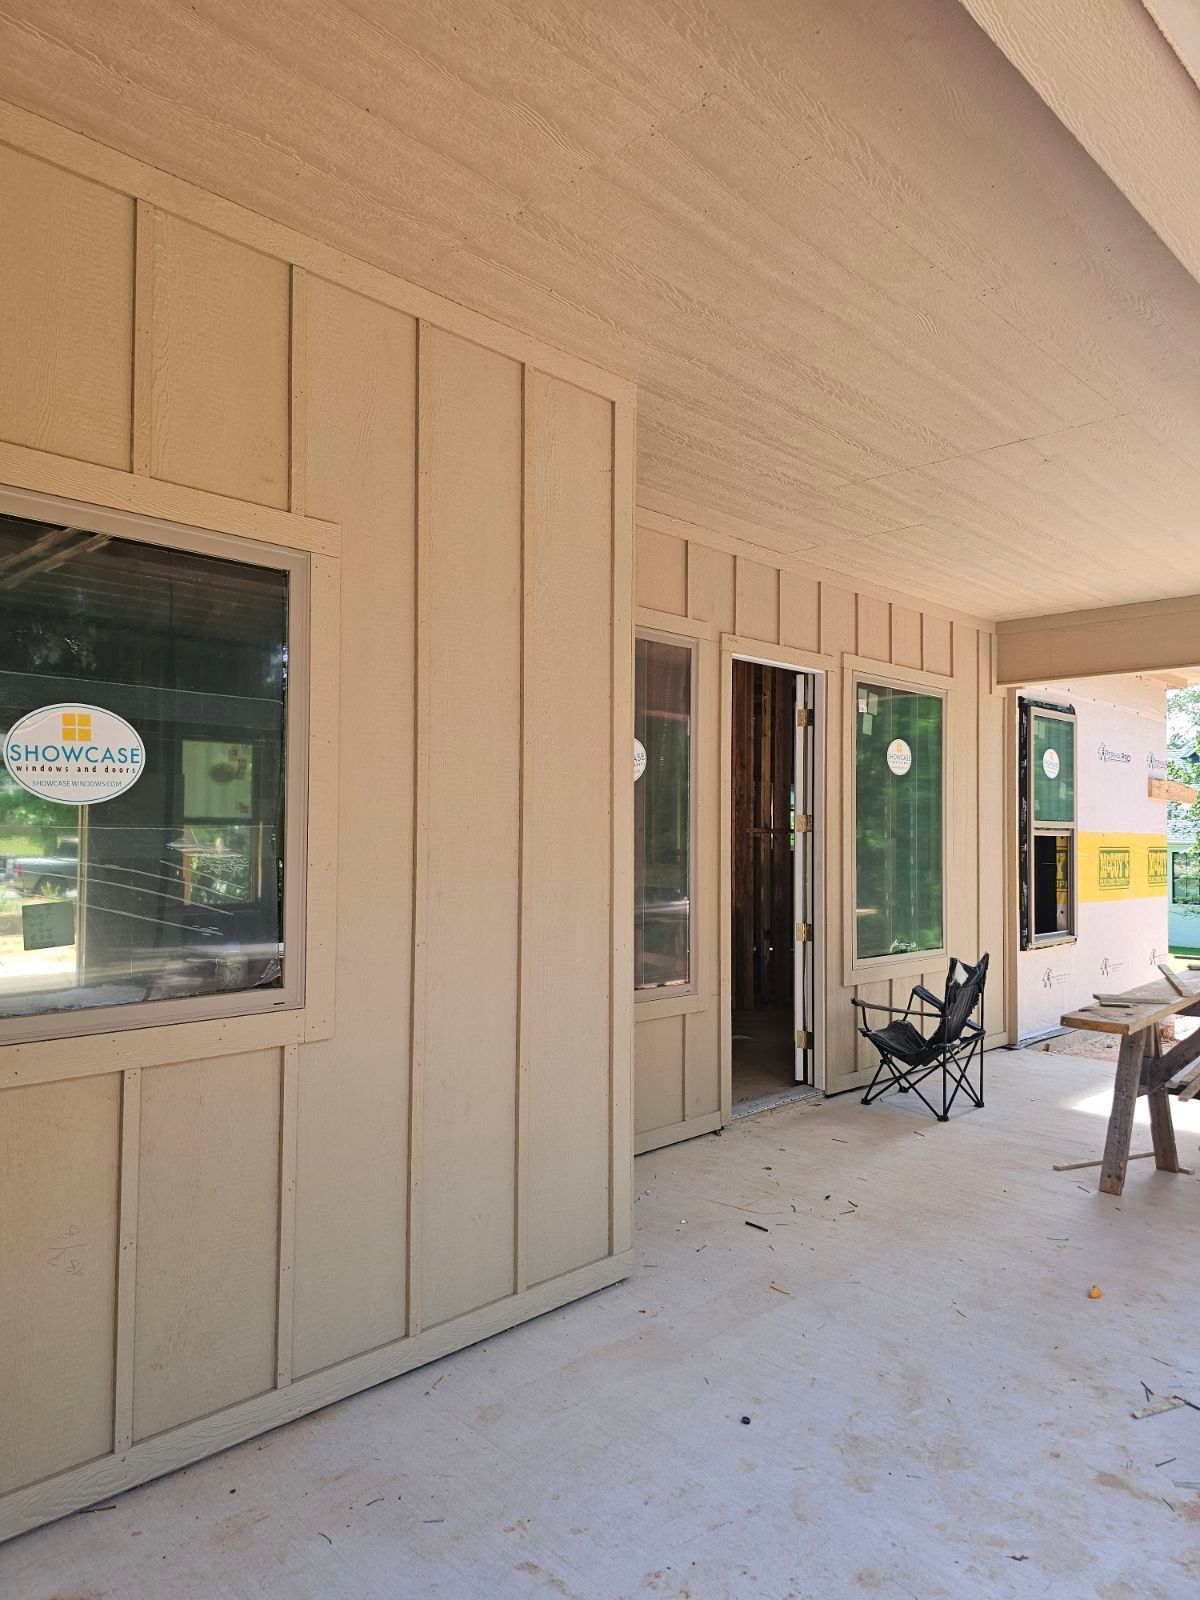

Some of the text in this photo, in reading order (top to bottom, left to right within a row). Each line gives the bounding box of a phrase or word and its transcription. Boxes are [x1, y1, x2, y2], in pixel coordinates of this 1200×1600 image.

[9, 744, 140, 764] SHOWCASE
[16, 764, 136, 774] windows and doors
